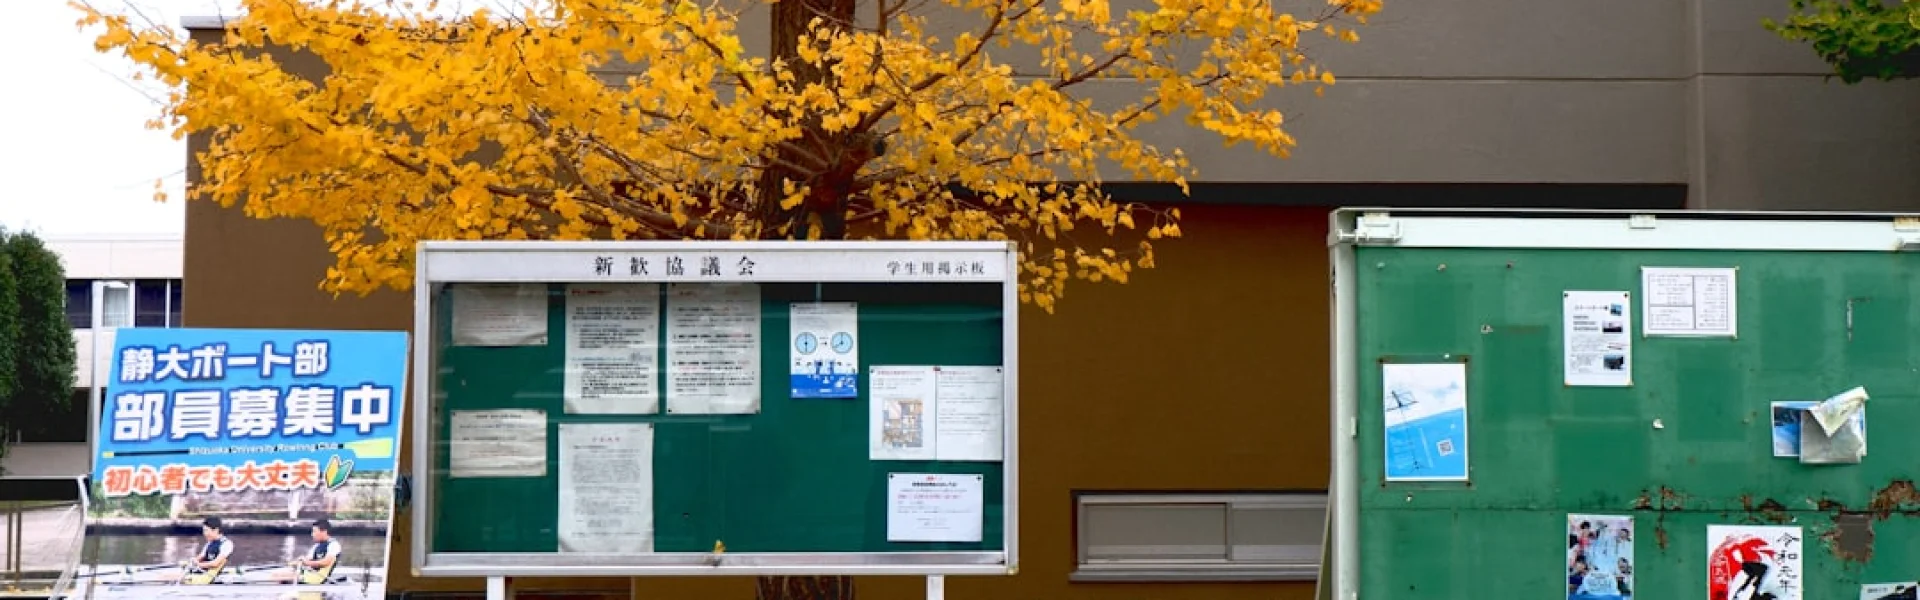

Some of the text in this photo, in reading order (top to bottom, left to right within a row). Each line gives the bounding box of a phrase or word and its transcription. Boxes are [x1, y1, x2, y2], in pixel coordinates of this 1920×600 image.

[886, 260, 985, 276] 学生用掲示板
[120, 341, 328, 382] 静大ボート部
[113, 384, 391, 441] 部員募集中
[104, 461, 319, 494] 初心者でも大丈夫
